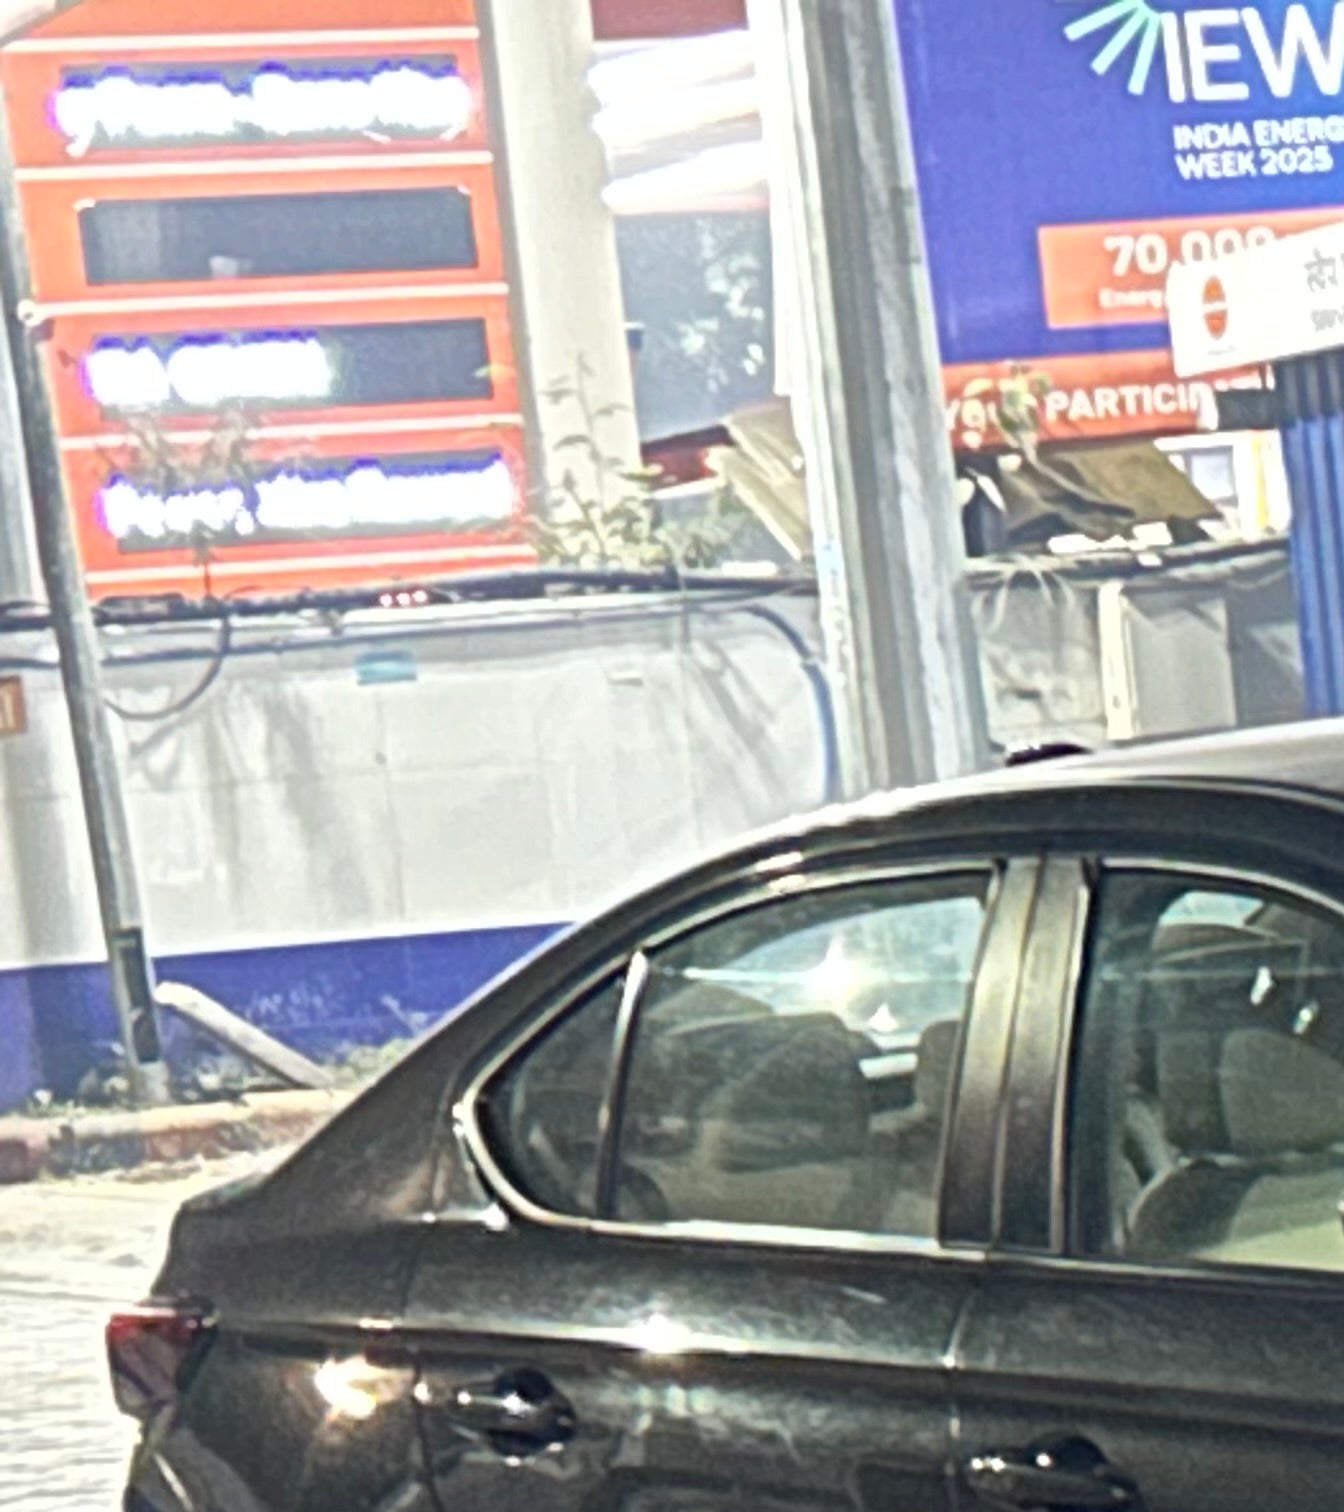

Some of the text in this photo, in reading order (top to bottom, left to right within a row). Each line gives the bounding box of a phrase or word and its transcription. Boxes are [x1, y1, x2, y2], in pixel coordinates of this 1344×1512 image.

[1173, 121, 1251, 150] INDIA
[1174, 144, 1334, 180] WEEK 2025
